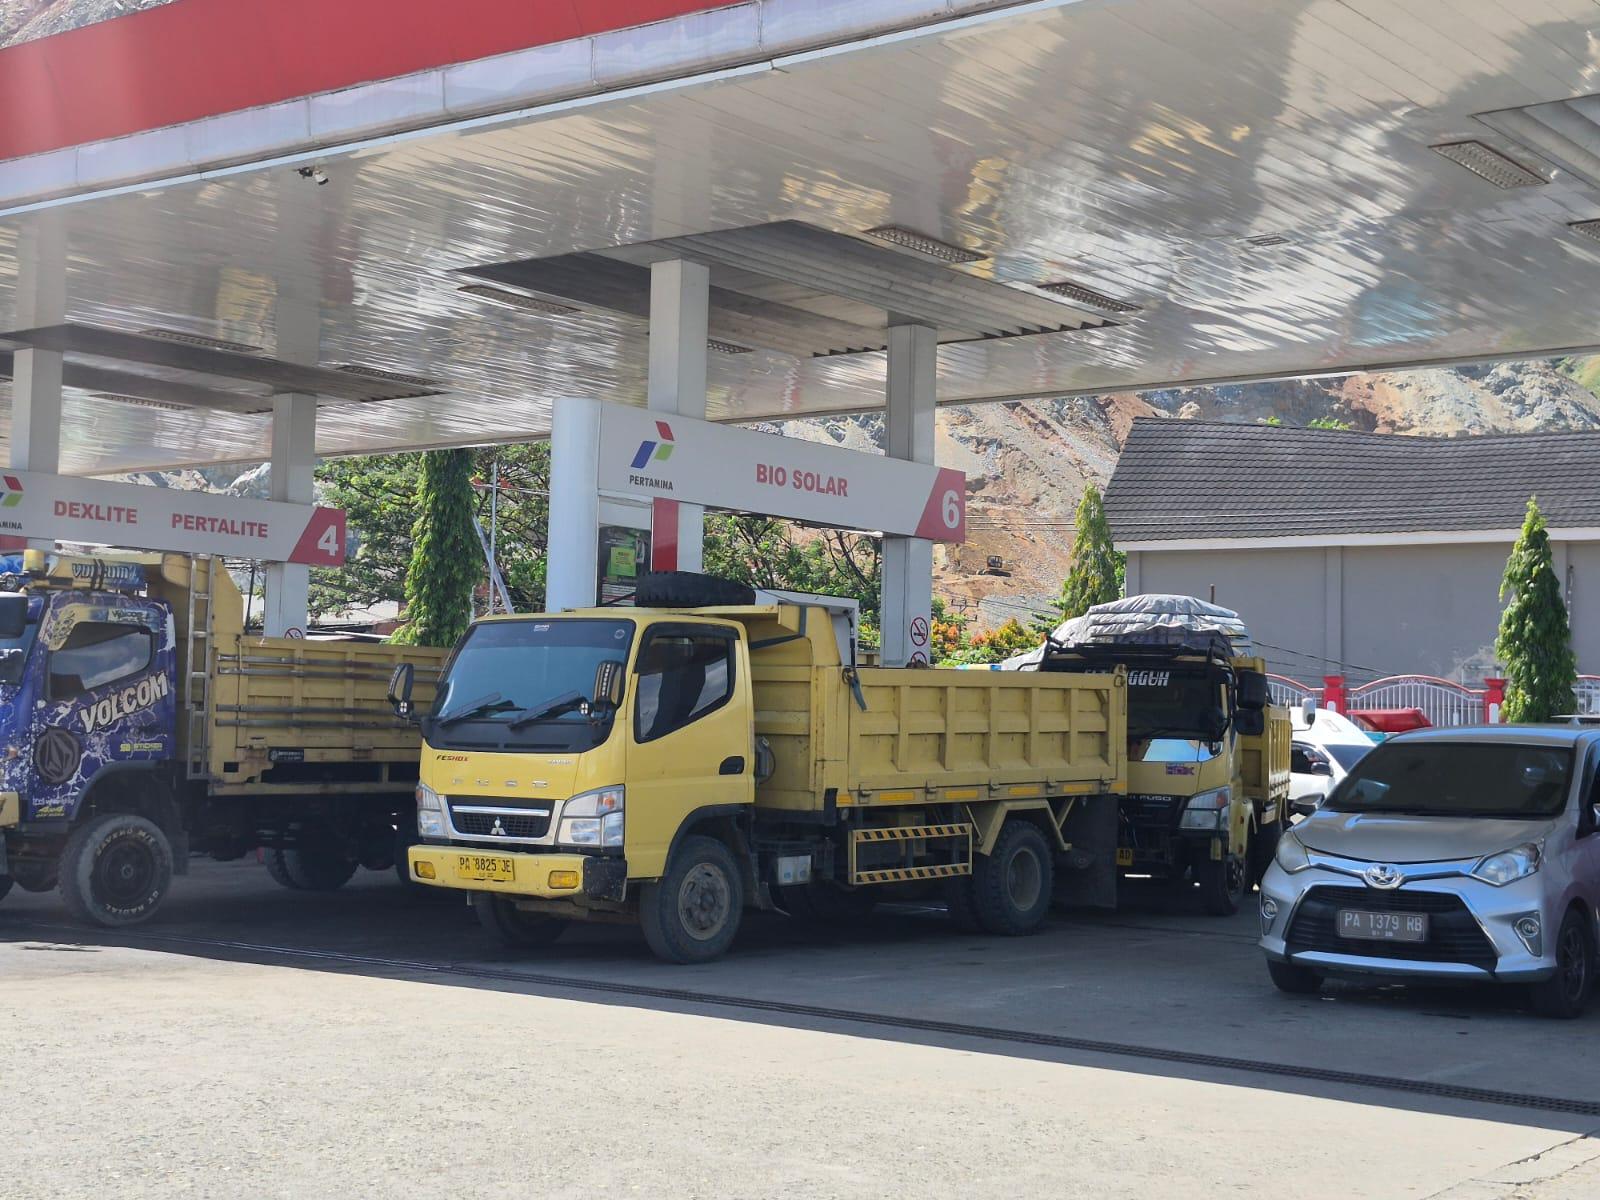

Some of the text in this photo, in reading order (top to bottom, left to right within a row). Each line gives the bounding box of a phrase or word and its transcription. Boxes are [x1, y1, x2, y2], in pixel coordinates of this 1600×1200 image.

[629, 475, 674, 491] PERTAMINA
[756, 463, 848, 498] BIO SOLAR
[54, 500, 268, 538] DEXLITE PERTALITE
[941, 490, 961, 529] 6
[317, 525, 339, 556] 4
[1127, 670, 1170, 687] GGUH
[80, 672, 169, 733] VOLCOM
[459, 857, 511, 873] PA 8825 JE
[1344, 912, 1423, 931] PA 1379 RB
